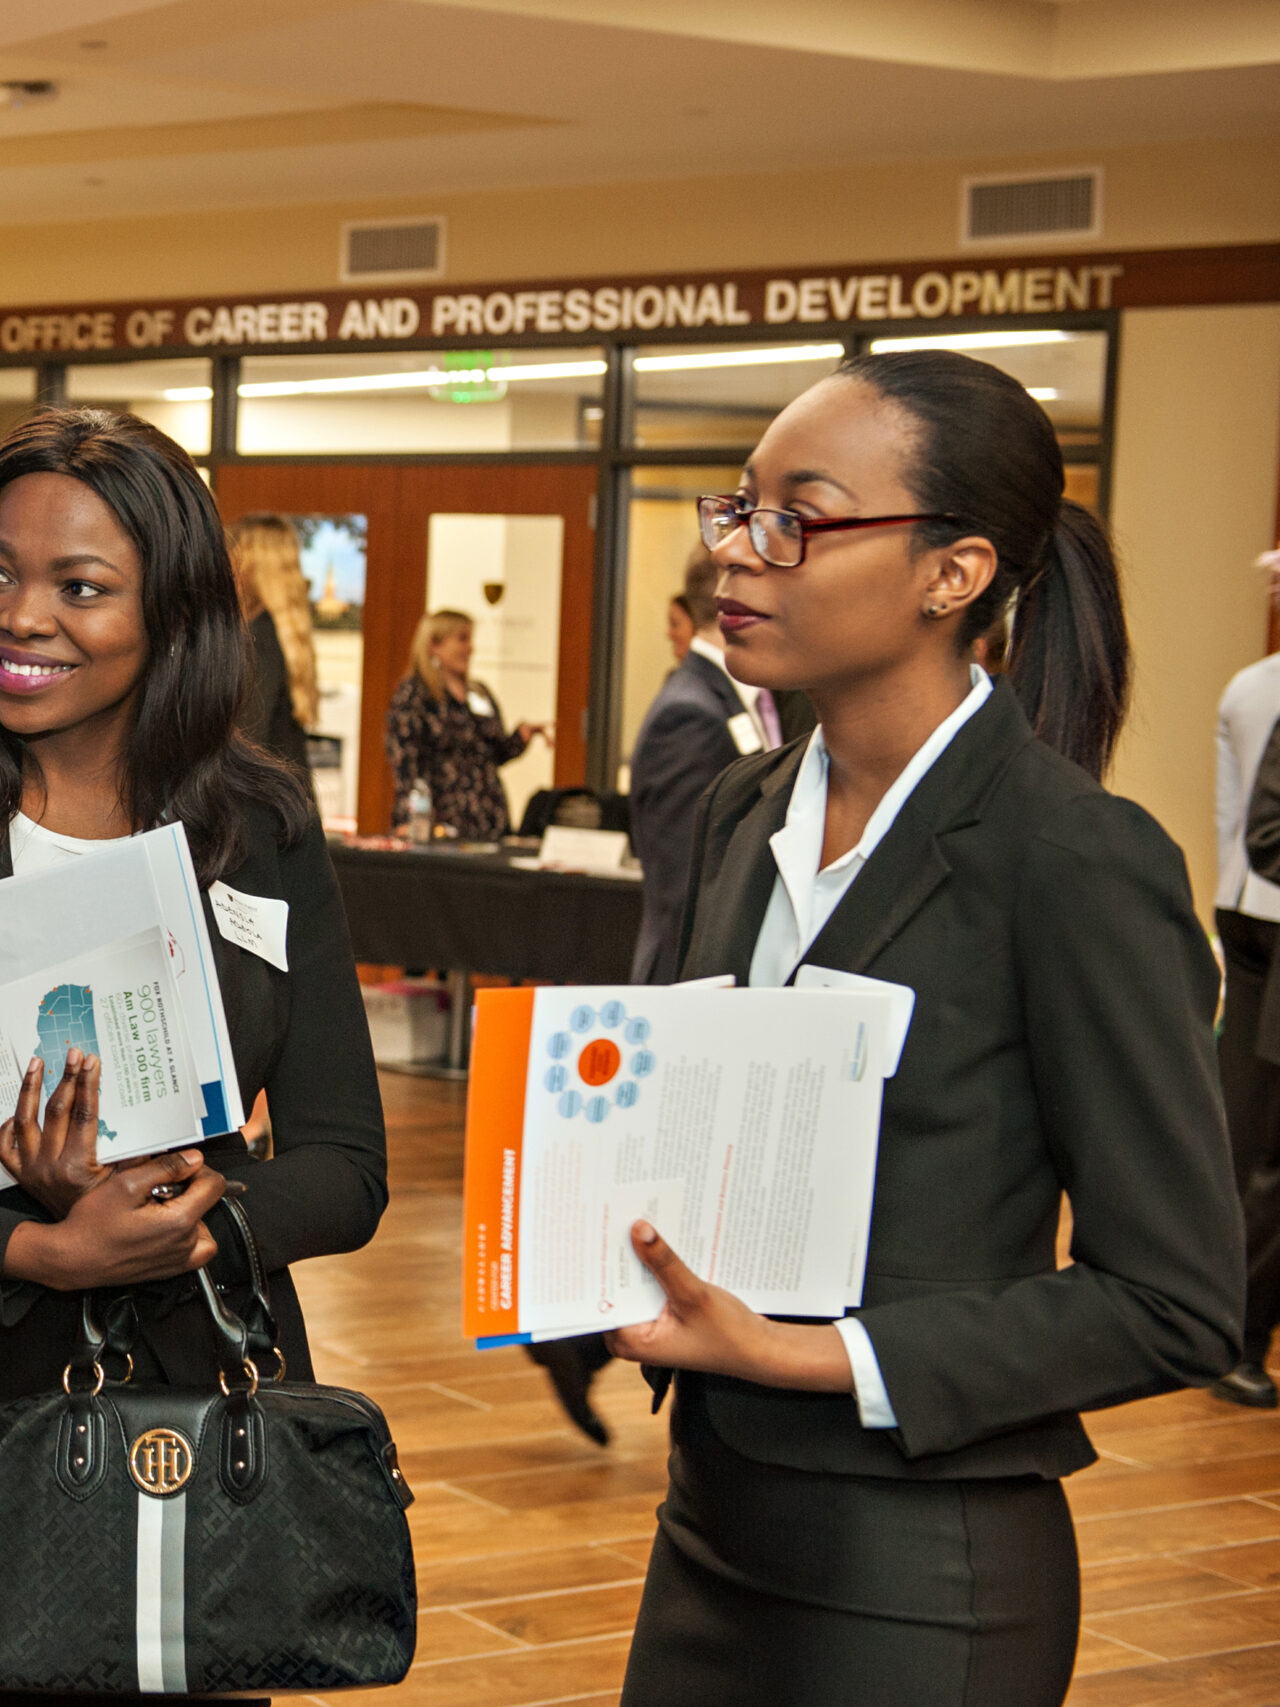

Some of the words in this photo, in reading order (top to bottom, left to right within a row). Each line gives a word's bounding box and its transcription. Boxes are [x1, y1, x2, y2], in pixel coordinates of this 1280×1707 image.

[0, 312, 115, 352] OFFICE
[126, 309, 174, 348] OF
[185, 301, 327, 345] CAREER
[338, 296, 418, 339] AND
[432, 282, 750, 336] PROFESSIONAL
[765, 265, 1122, 323] DEVELOPMENT
[123, 991, 134, 1011] Am
[137, 985, 156, 1023] 900
[129, 1015, 140, 1041] Law
[157, 998, 170, 1044] ROTHSCHILD
[166, 1046, 173, 1055] AT
[170, 1065, 179, 1093] GLANCE
[136, 1047, 148, 1072] 100
[146, 1028, 167, 1098] lawyers
[141, 1076, 151, 1102] firm
[501, 1148, 515, 1251] ADVANCEMENT
[500, 1253, 512, 1310] CAREER
